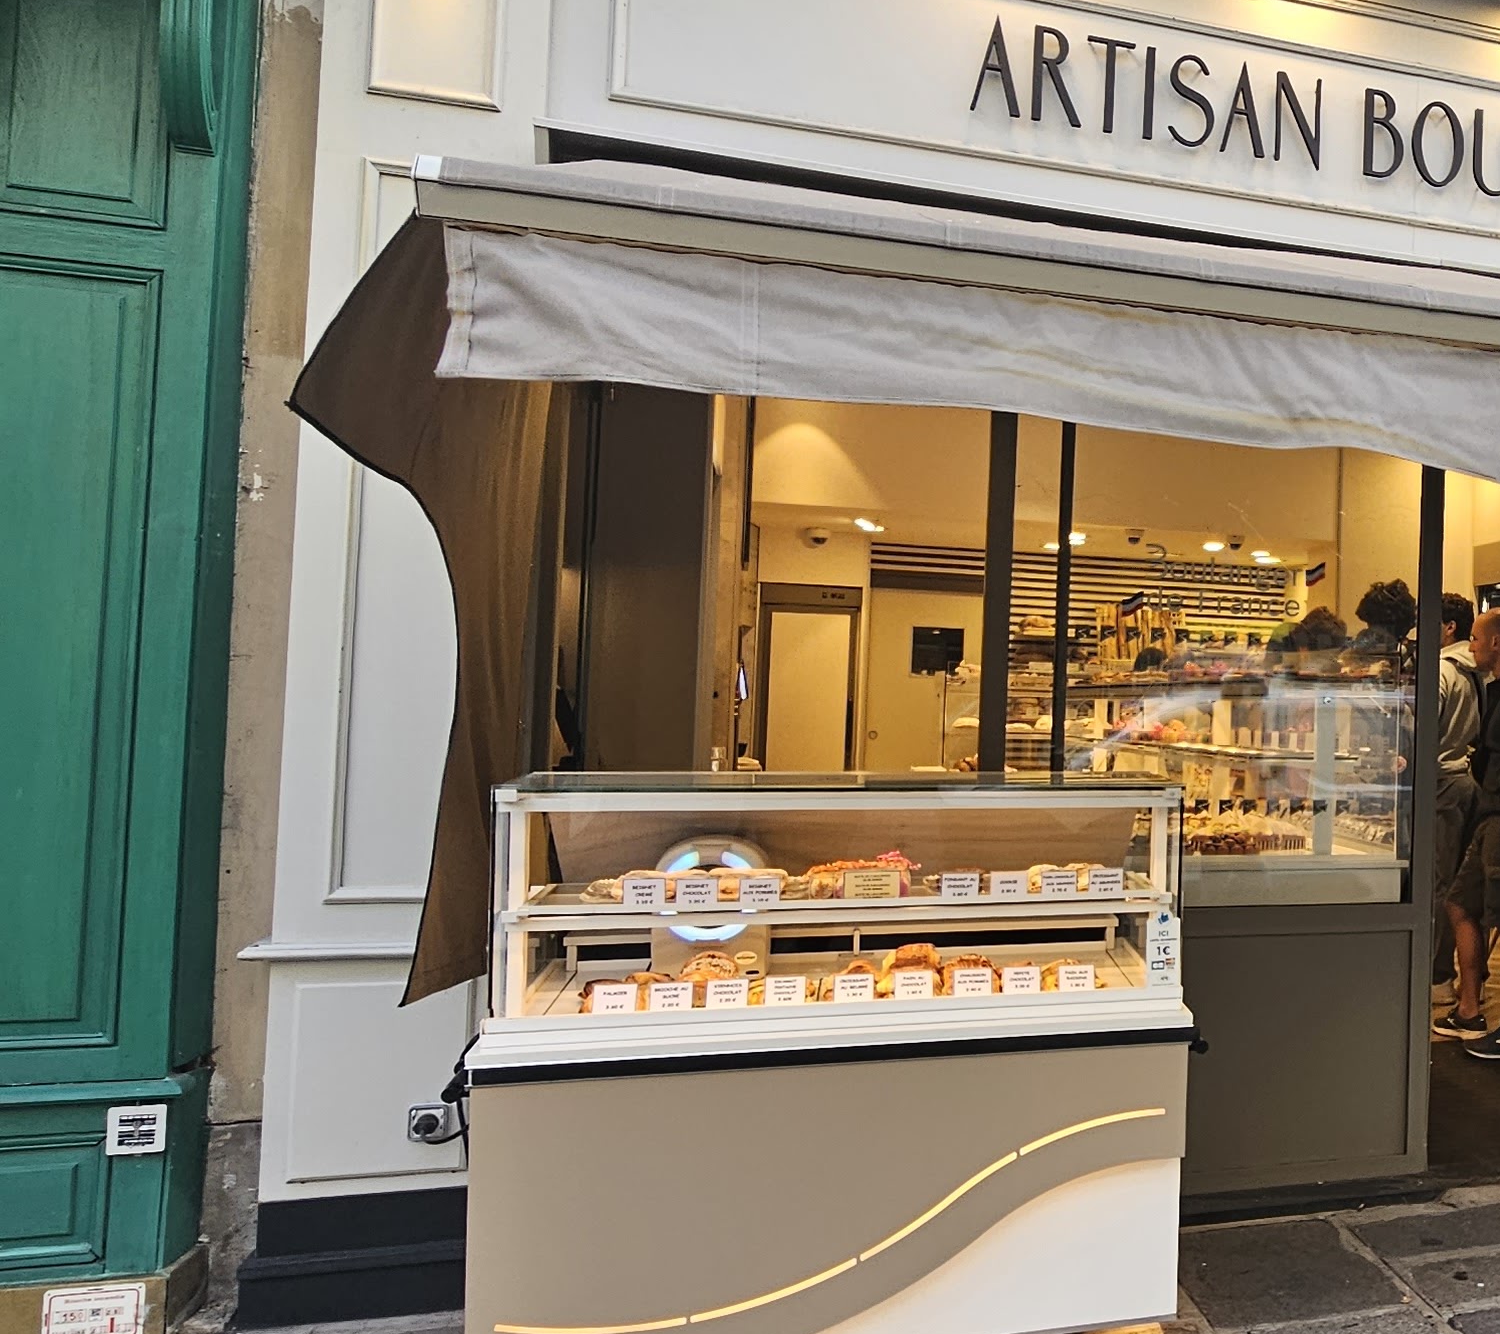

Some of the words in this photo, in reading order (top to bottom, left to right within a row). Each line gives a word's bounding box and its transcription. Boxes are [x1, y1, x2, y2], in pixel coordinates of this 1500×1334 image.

[969, 14, 1323, 172] ARTISAN
[1147, 585, 1184, 612] de
[1198, 588, 1301, 617] France
